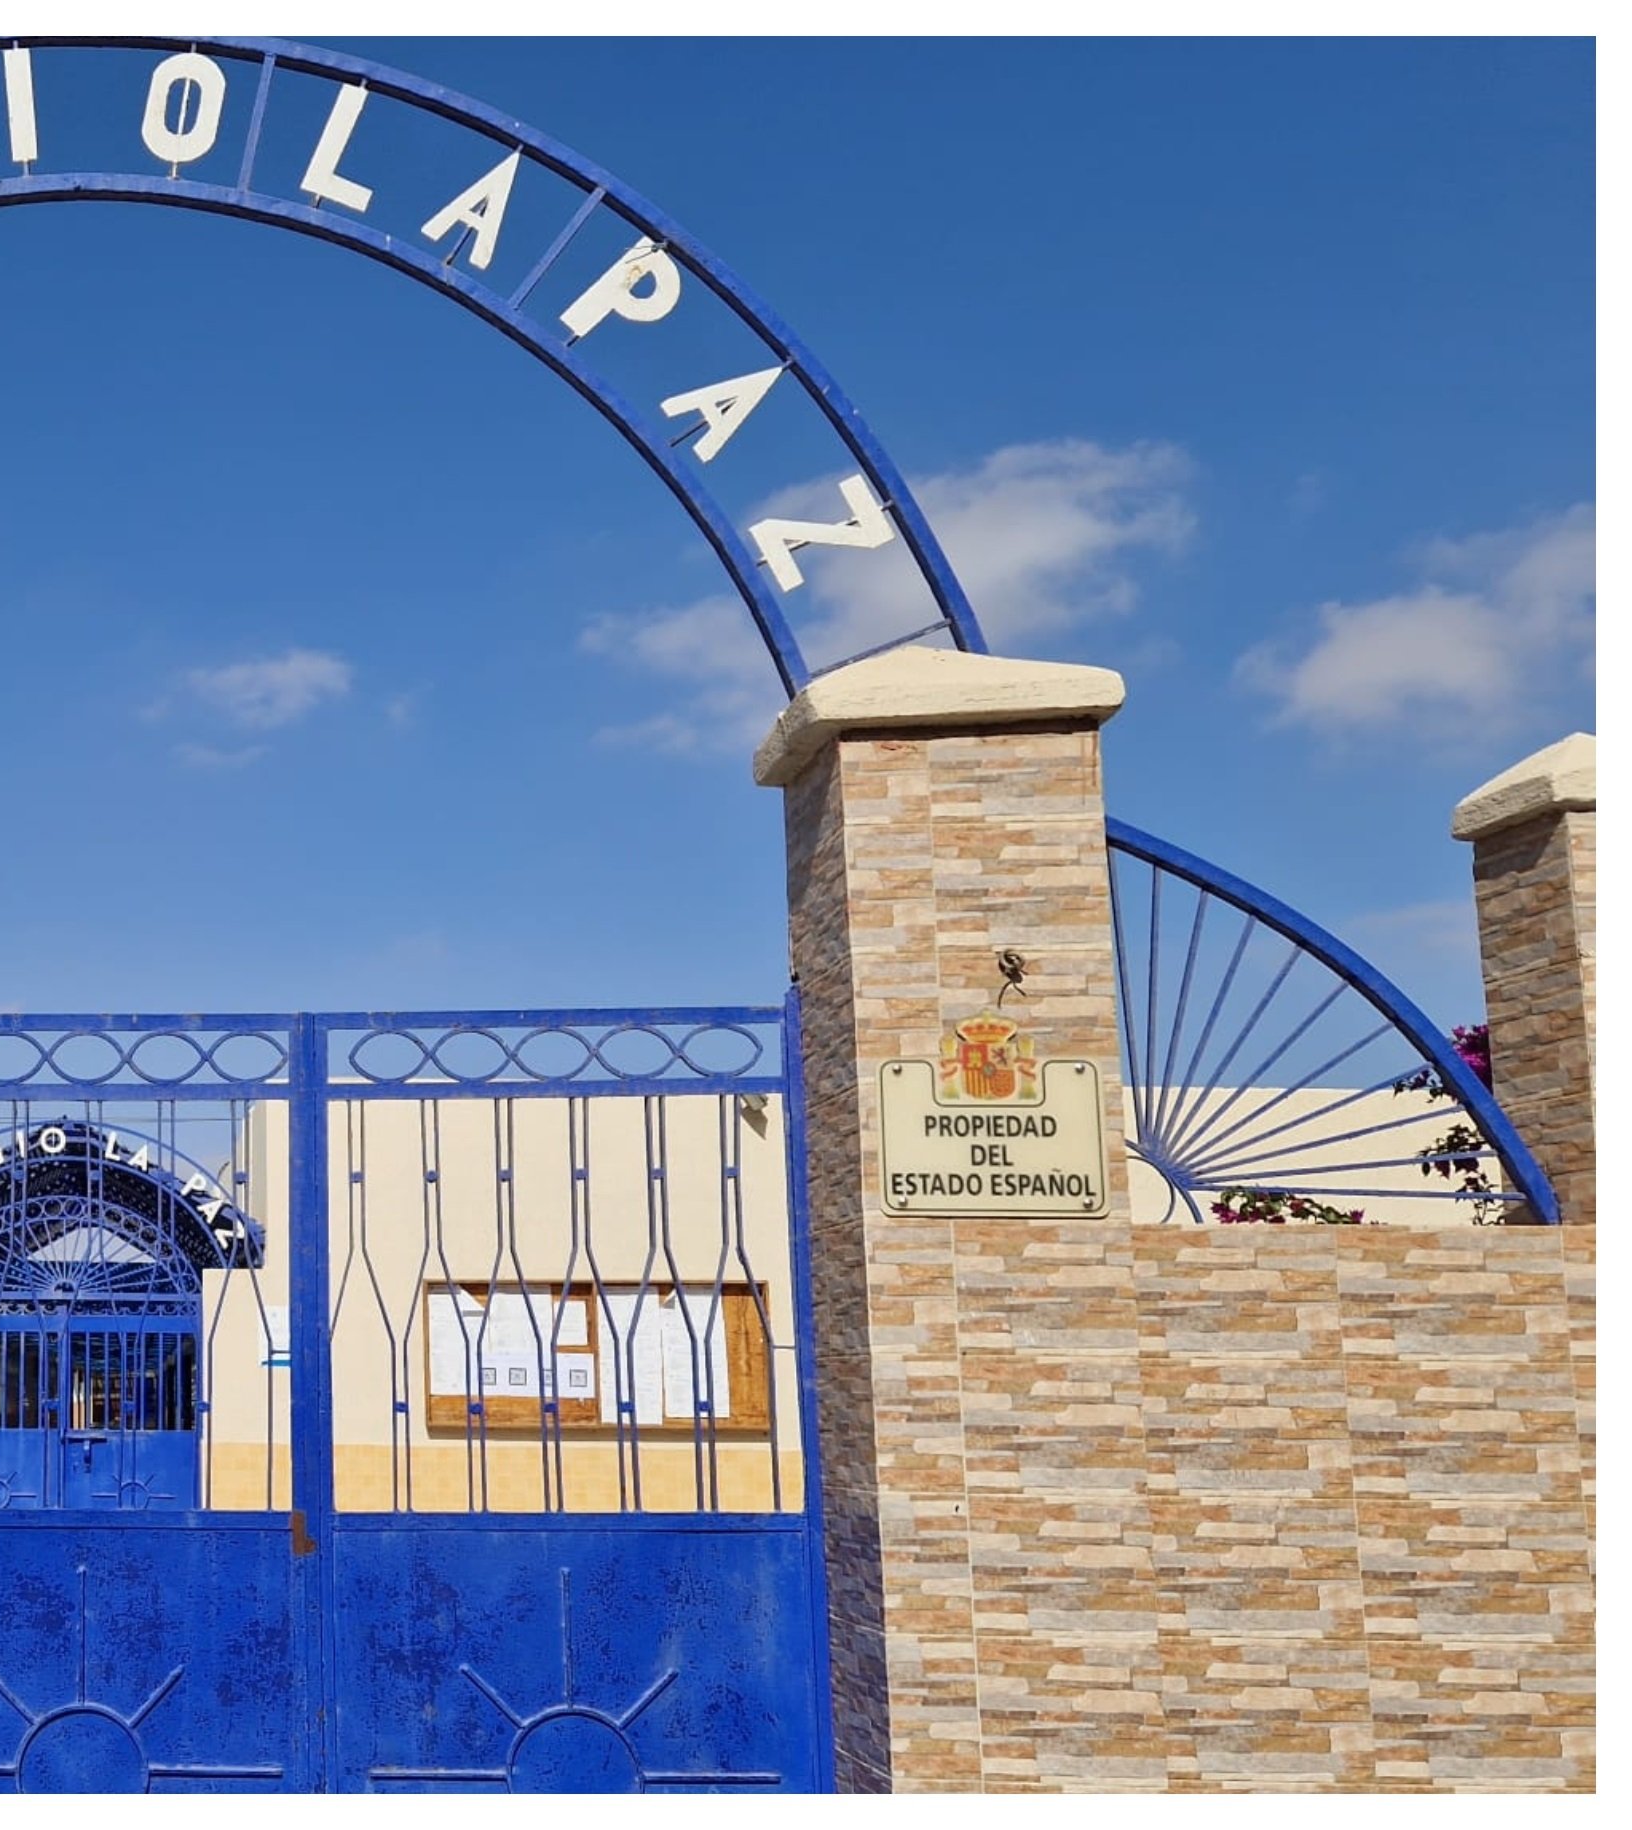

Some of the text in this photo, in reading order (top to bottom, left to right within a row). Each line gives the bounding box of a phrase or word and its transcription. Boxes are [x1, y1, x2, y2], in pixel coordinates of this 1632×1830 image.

[300, 82, 522, 270] LA
[559, 236, 896, 592] PAZ
[924, 1115, 1058, 1138] PROPIEDAD
[970, 1144, 1015, 1167] DEL
[105, 1131, 149, 1172] LA
[180, 1172, 246, 1250] PAZ
[891, 1167, 1097, 1197] ESTADO ESPAÑOL
